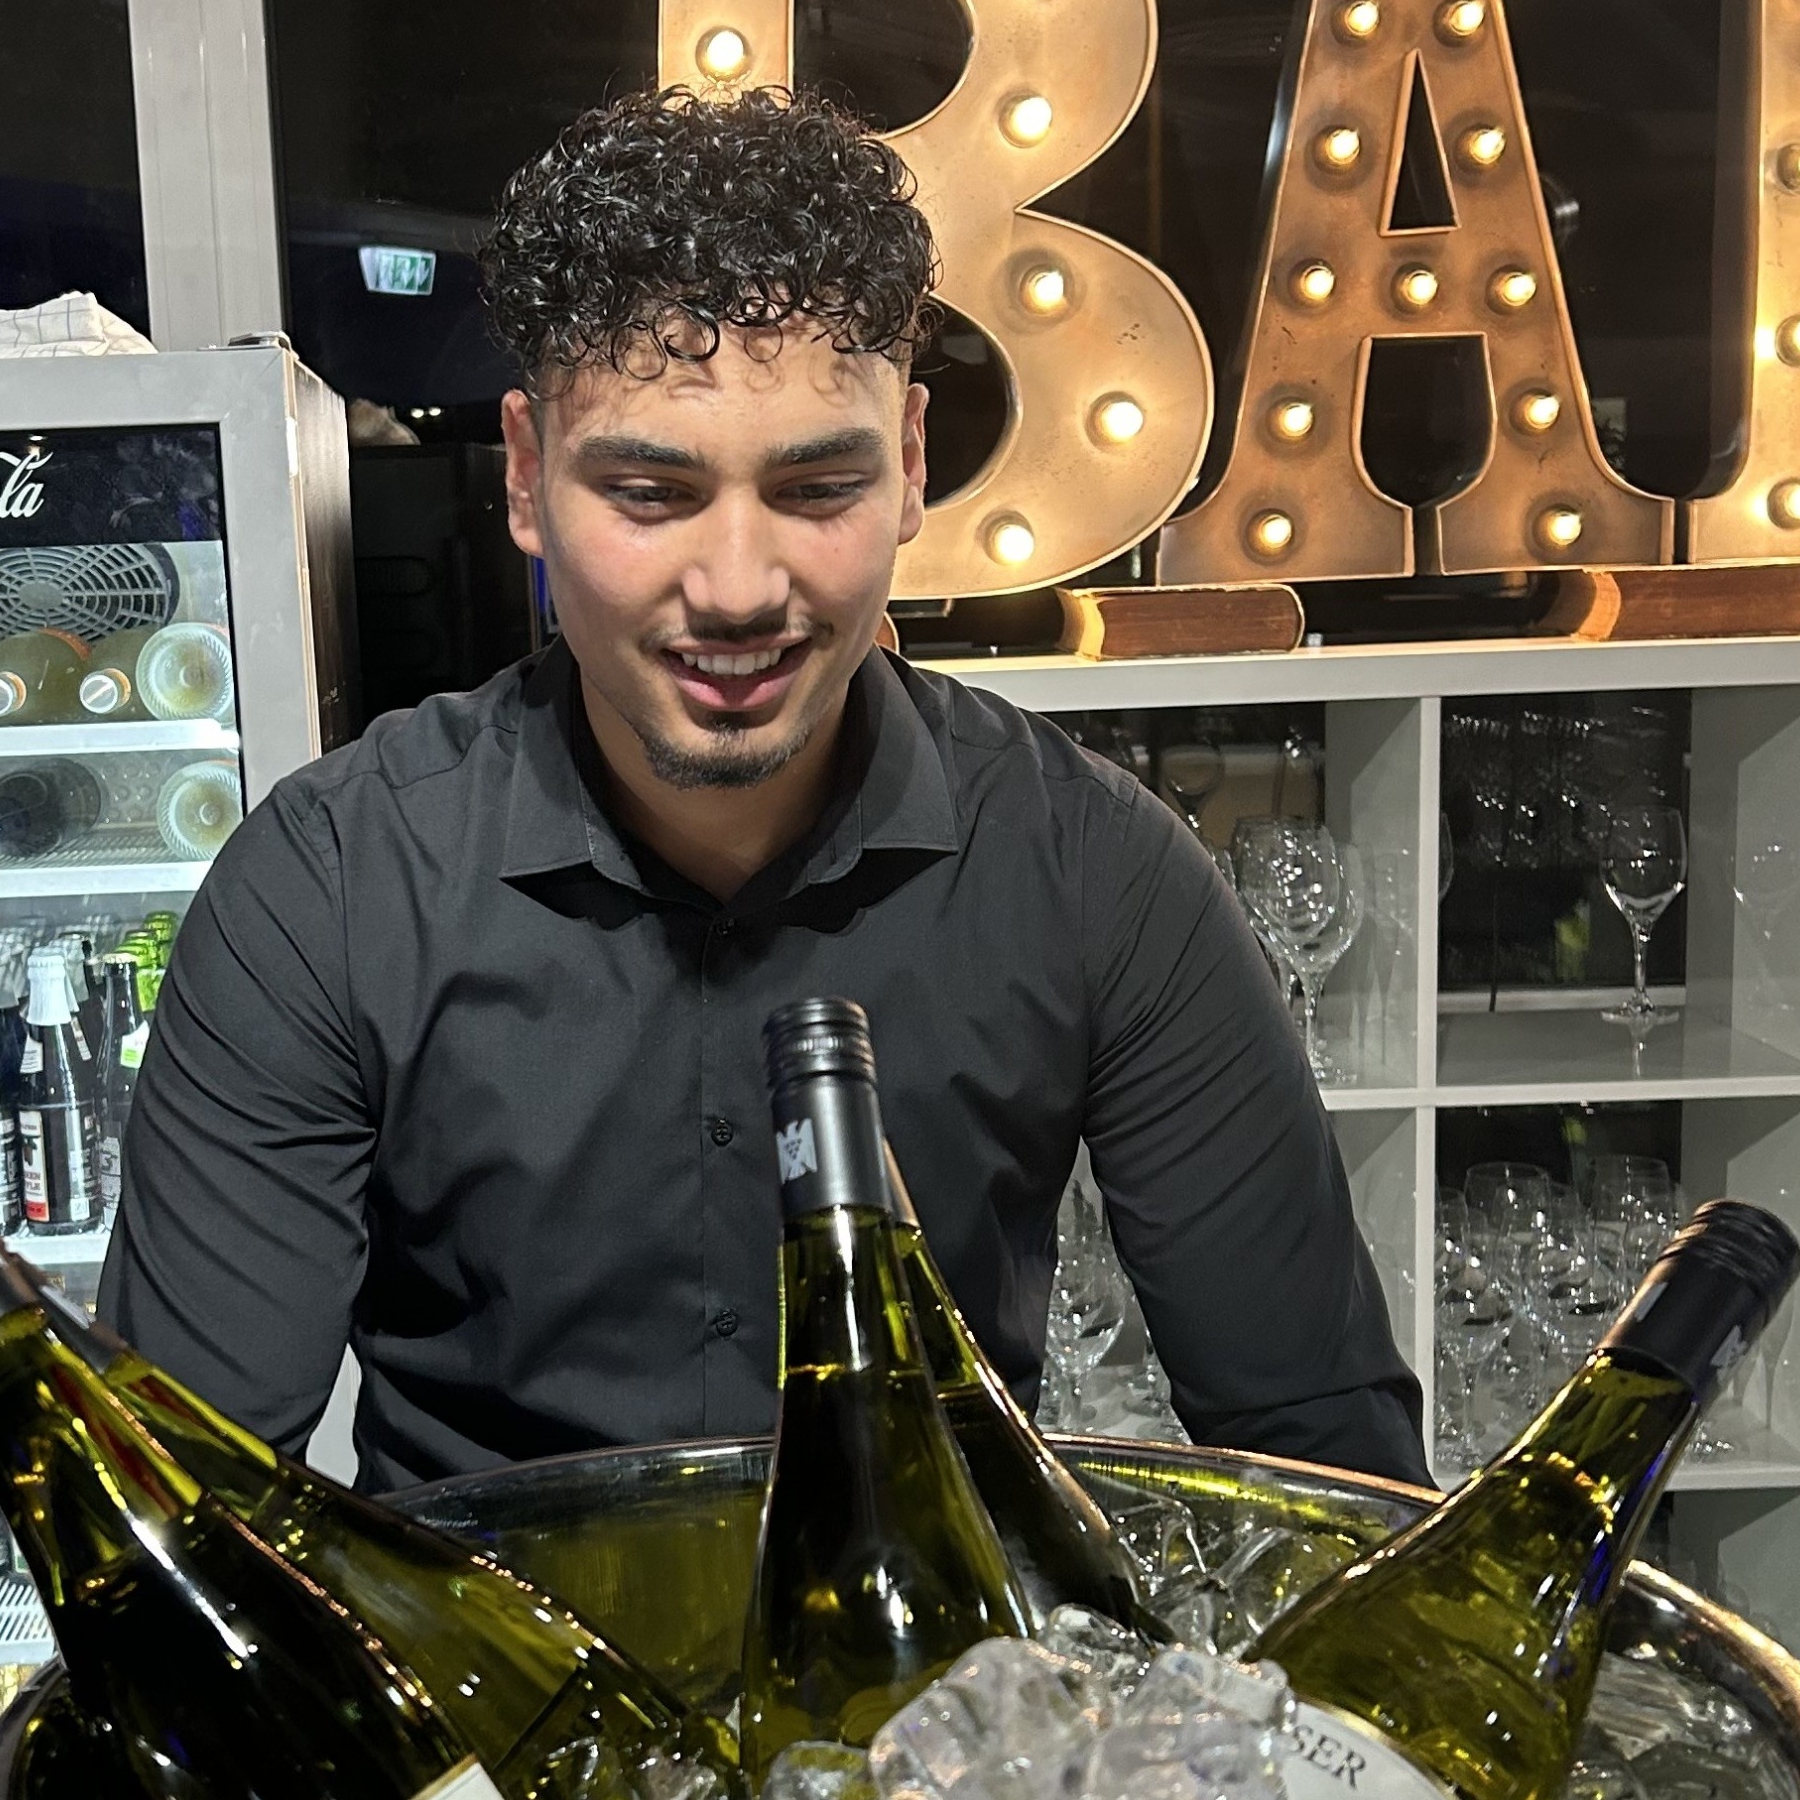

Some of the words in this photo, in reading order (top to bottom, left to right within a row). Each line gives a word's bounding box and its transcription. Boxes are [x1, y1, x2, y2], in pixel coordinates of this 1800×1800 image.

[658, 0, 1800, 598] BA
[0, 452, 52, 518] la
[1289, 1724, 1367, 1790] SER
